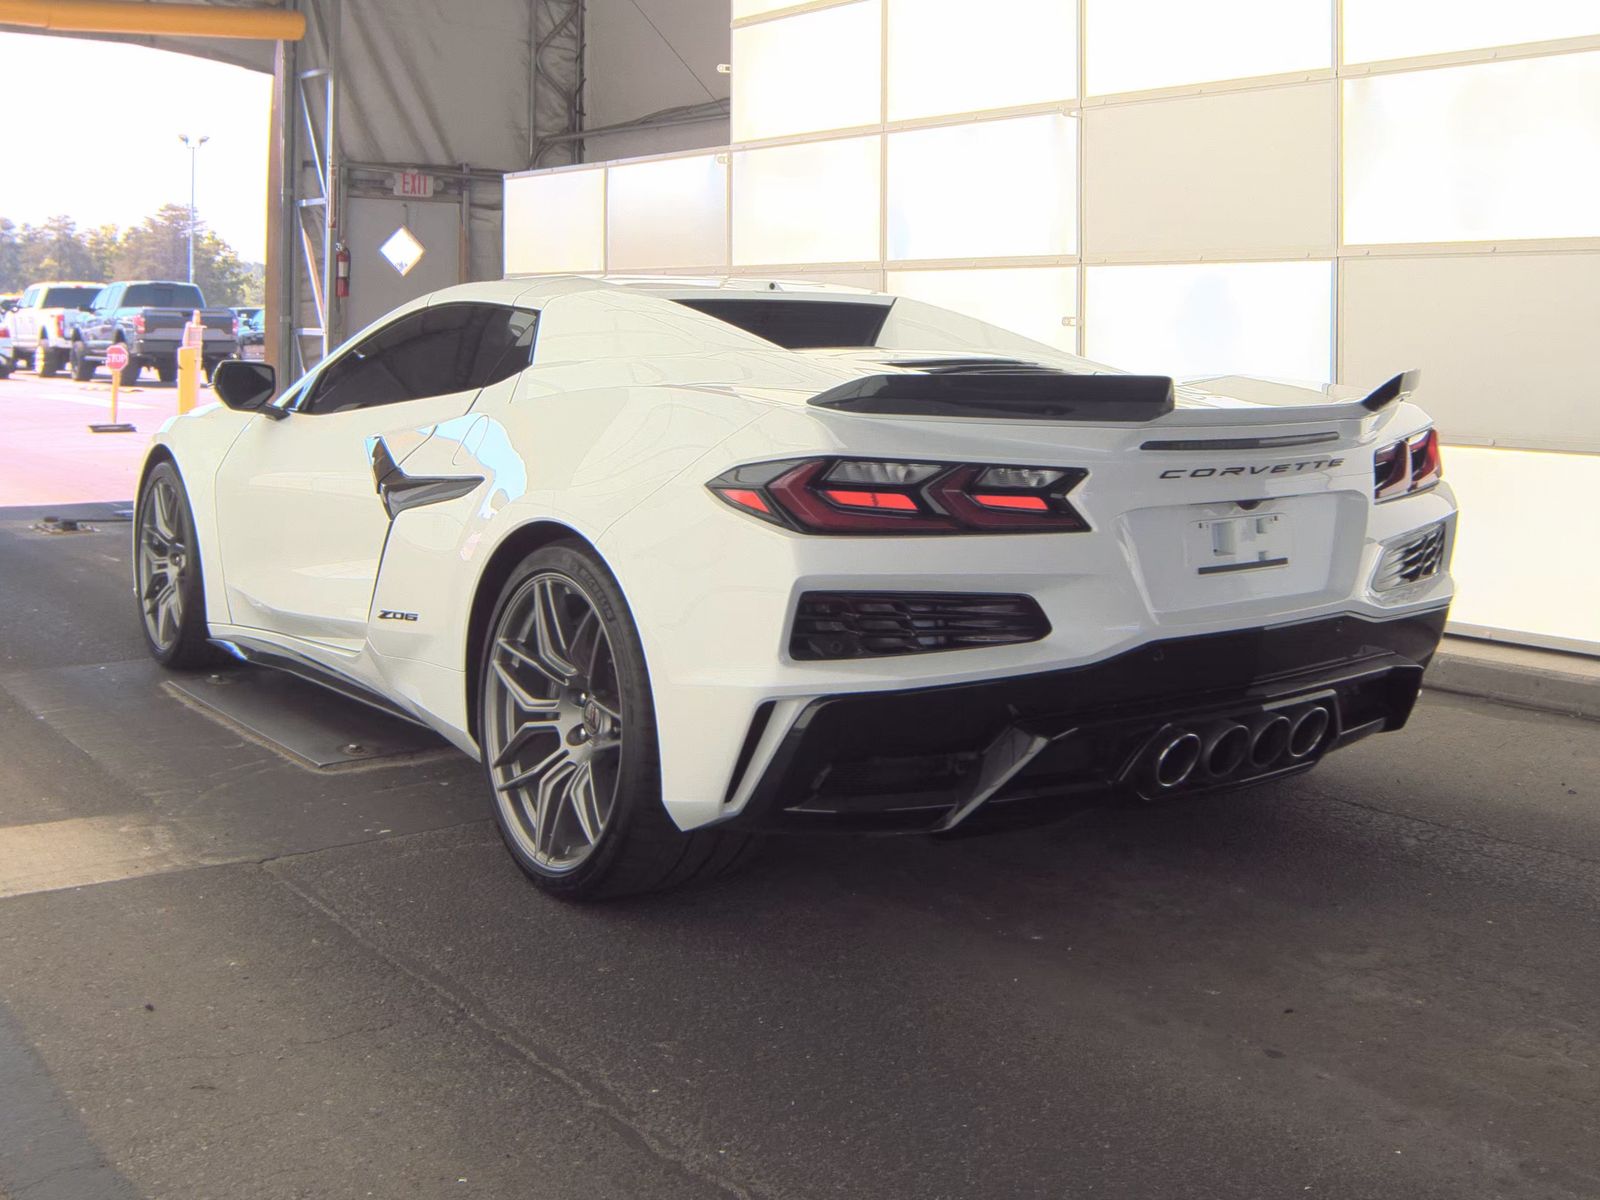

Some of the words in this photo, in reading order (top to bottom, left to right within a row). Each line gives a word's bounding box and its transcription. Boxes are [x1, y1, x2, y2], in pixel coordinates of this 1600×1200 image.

[107, 353, 127, 363] STOP
[1159, 458, 1345, 479] CORVETTE
[378, 610, 419, 621] Z06
